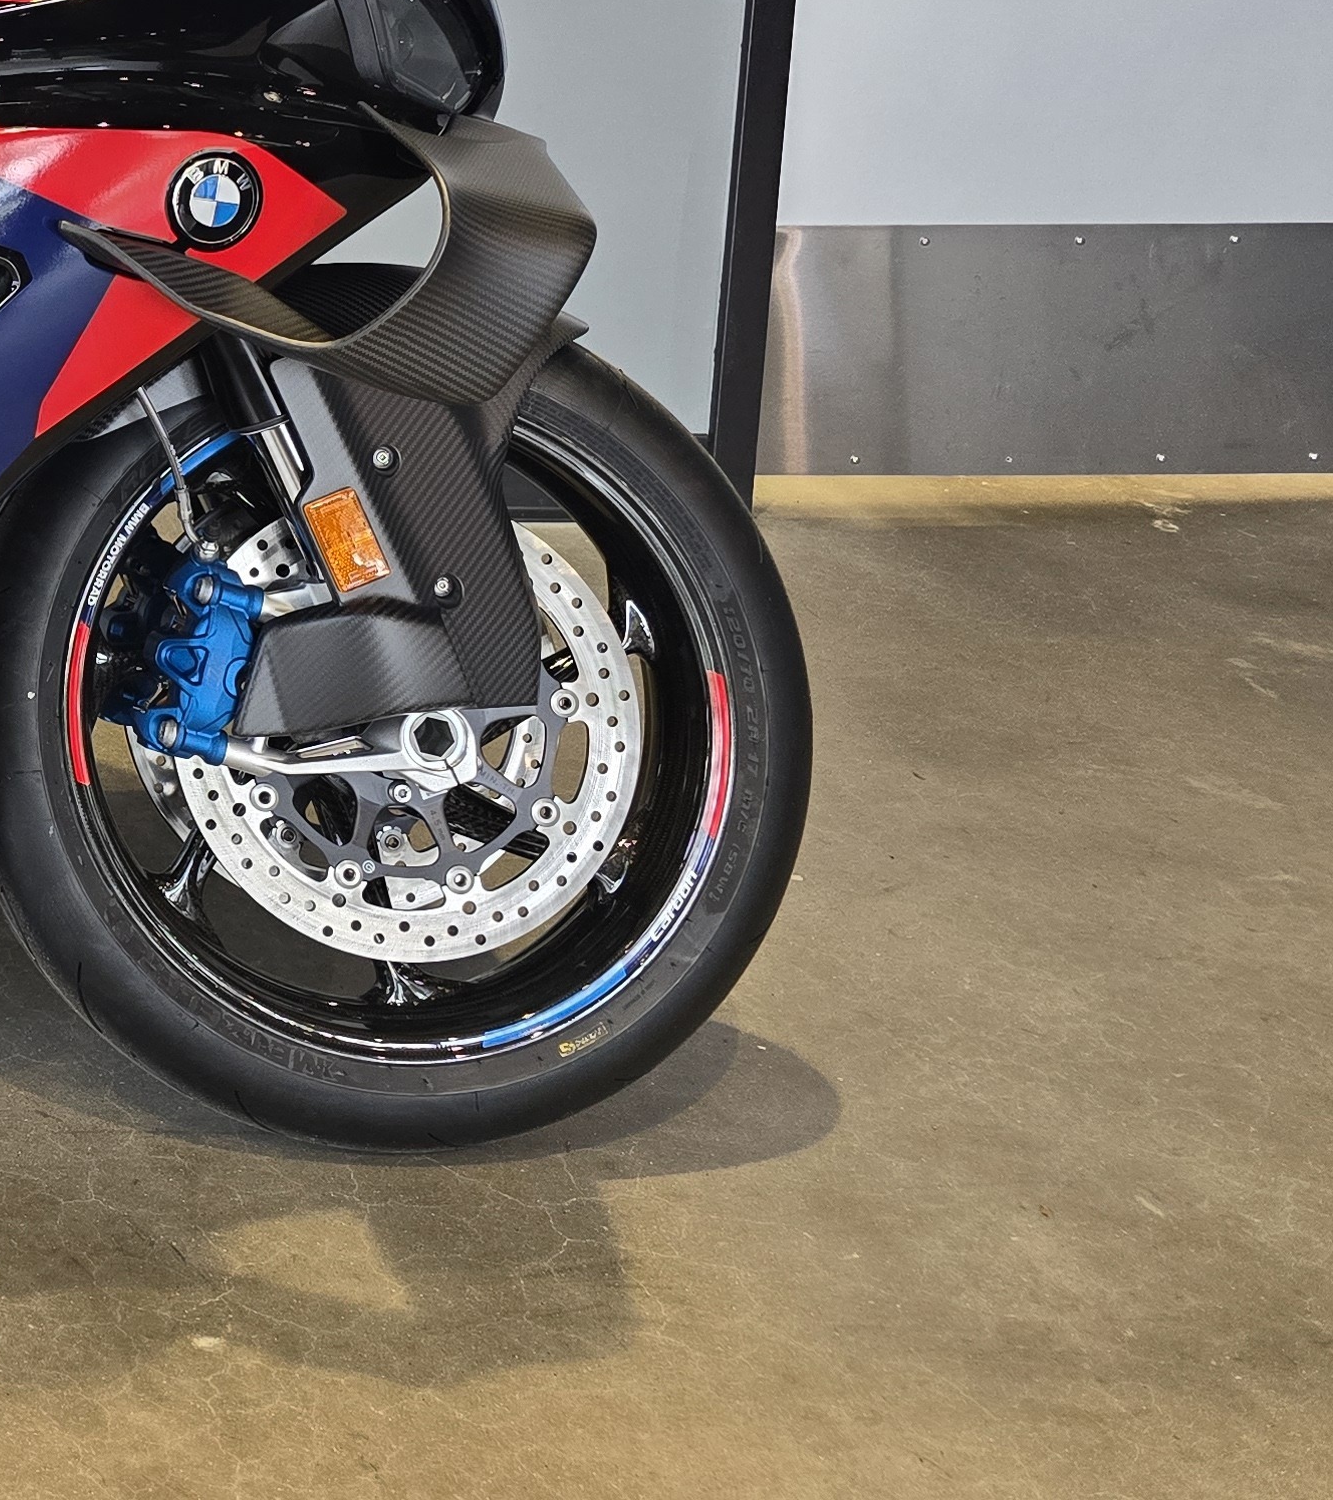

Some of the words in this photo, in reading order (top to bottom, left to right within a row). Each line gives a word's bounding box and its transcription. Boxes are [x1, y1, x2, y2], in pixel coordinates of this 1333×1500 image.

[186, 159, 252, 191] BMW
[124, 502, 151, 536] BMW
[87, 533, 128, 607] MOTORRAD
